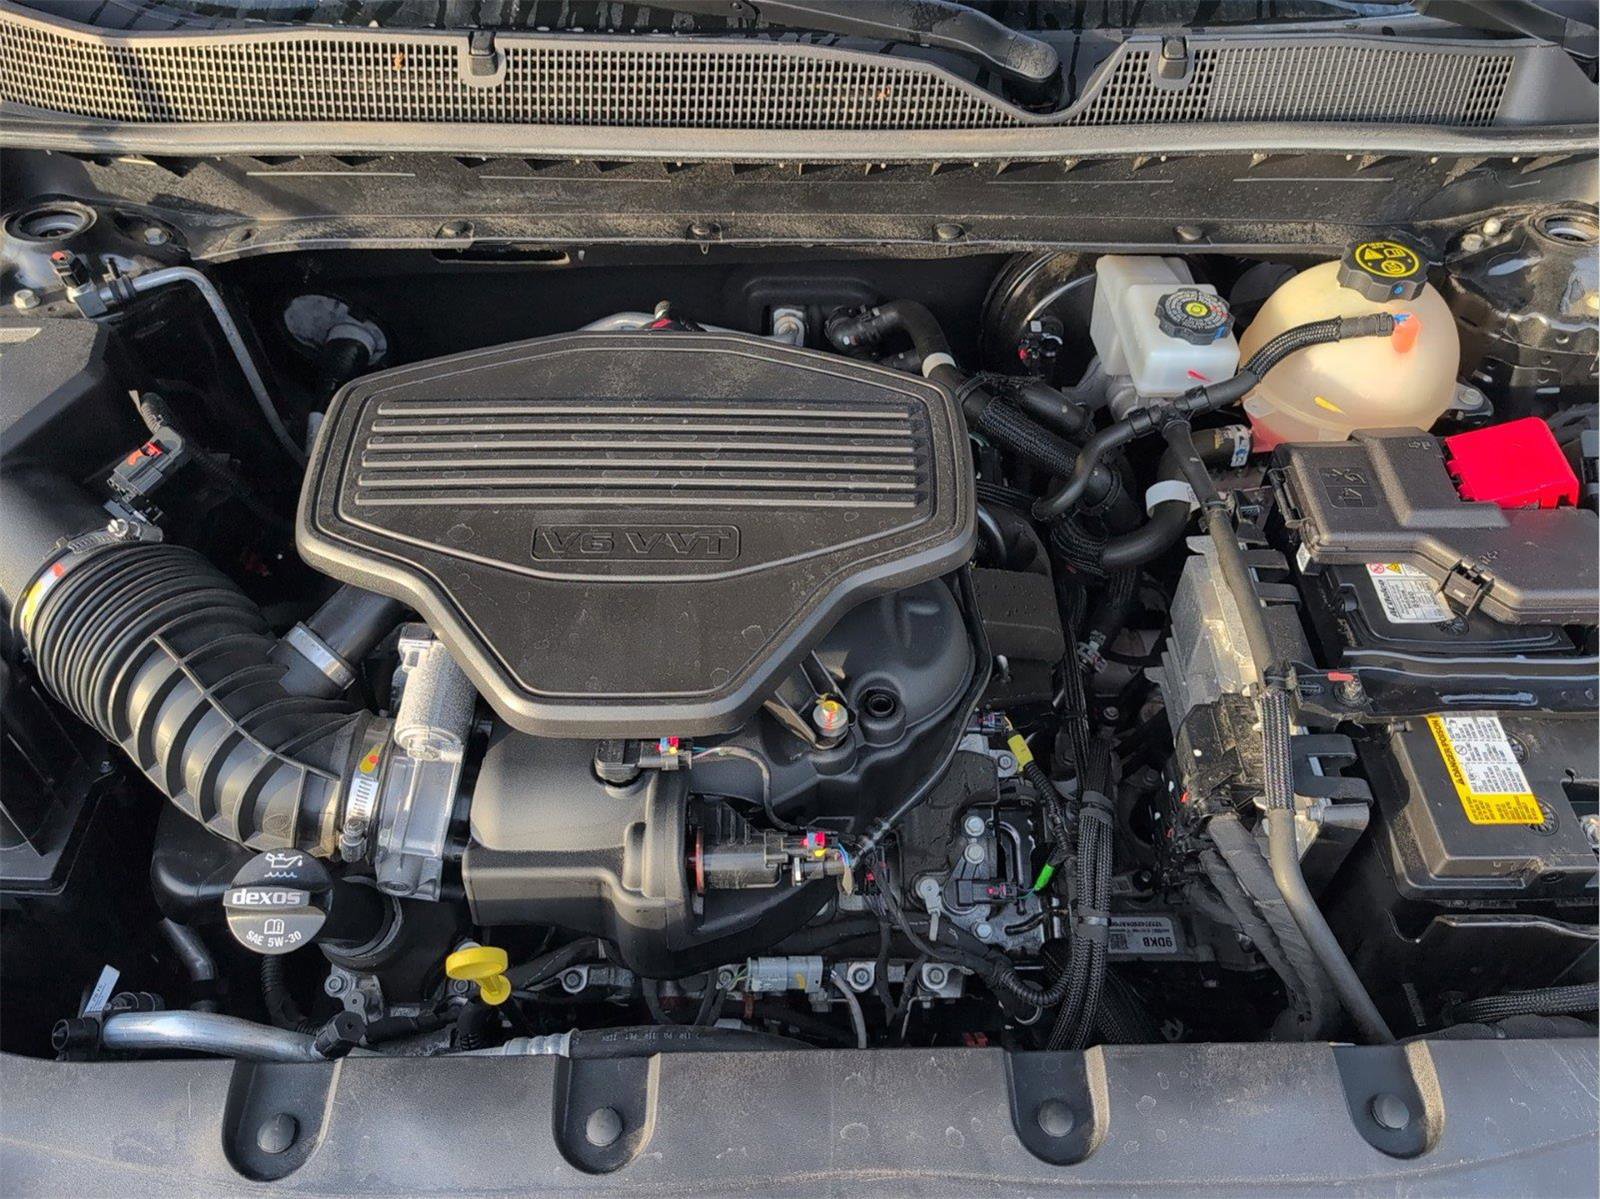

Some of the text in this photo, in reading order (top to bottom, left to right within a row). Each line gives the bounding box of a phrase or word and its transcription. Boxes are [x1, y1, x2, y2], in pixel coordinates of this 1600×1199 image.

[541, 531, 731, 554] V6 VVT
[232, 889, 302, 905] dexos
[246, 930, 302, 948] SAE 5W-30
